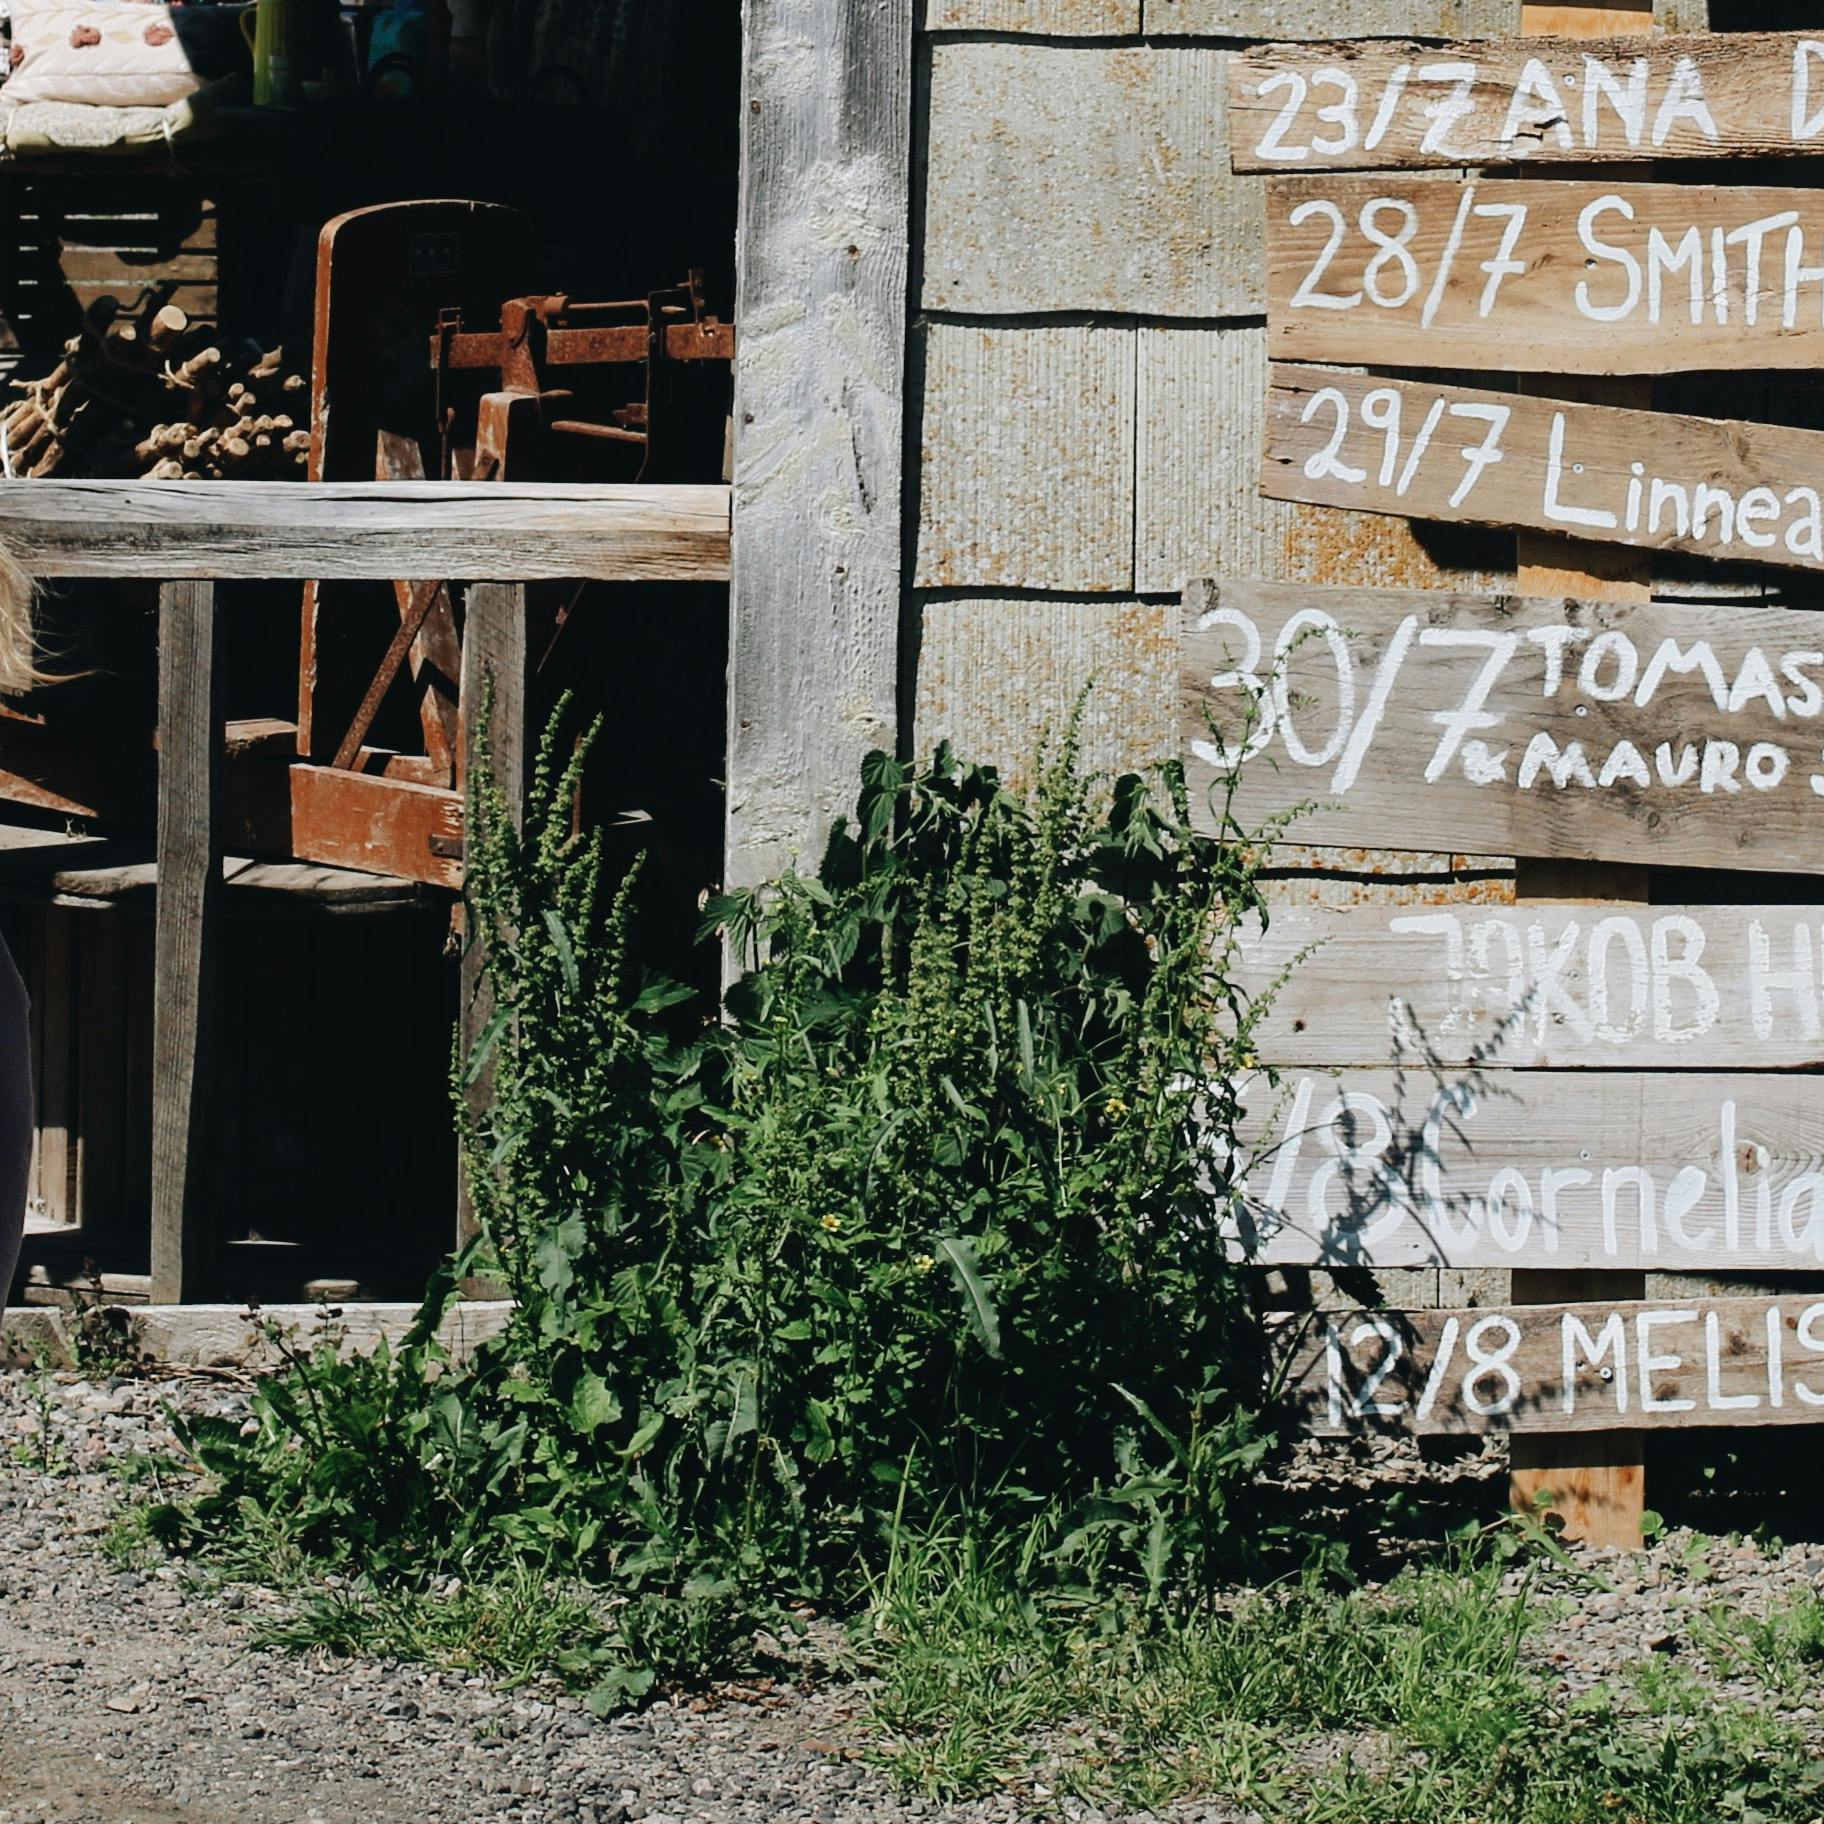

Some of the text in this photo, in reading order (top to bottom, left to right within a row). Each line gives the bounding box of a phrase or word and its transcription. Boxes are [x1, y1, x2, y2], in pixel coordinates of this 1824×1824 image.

[1253, 61, 1483, 162] 23/7
[1504, 54, 1721, 151] ANA
[1287, 185, 1529, 330] 28/7
[1301, 387, 1513, 509] 29/7
[1541, 411, 1824, 563] Linnea
[1188, 608, 1520, 796] 30/7
[1517, 729, 1791, 794] MAURO
[1388, 913, 1721, 1047] JAKOB
[1326, 1313, 1523, 1428] 12/8
